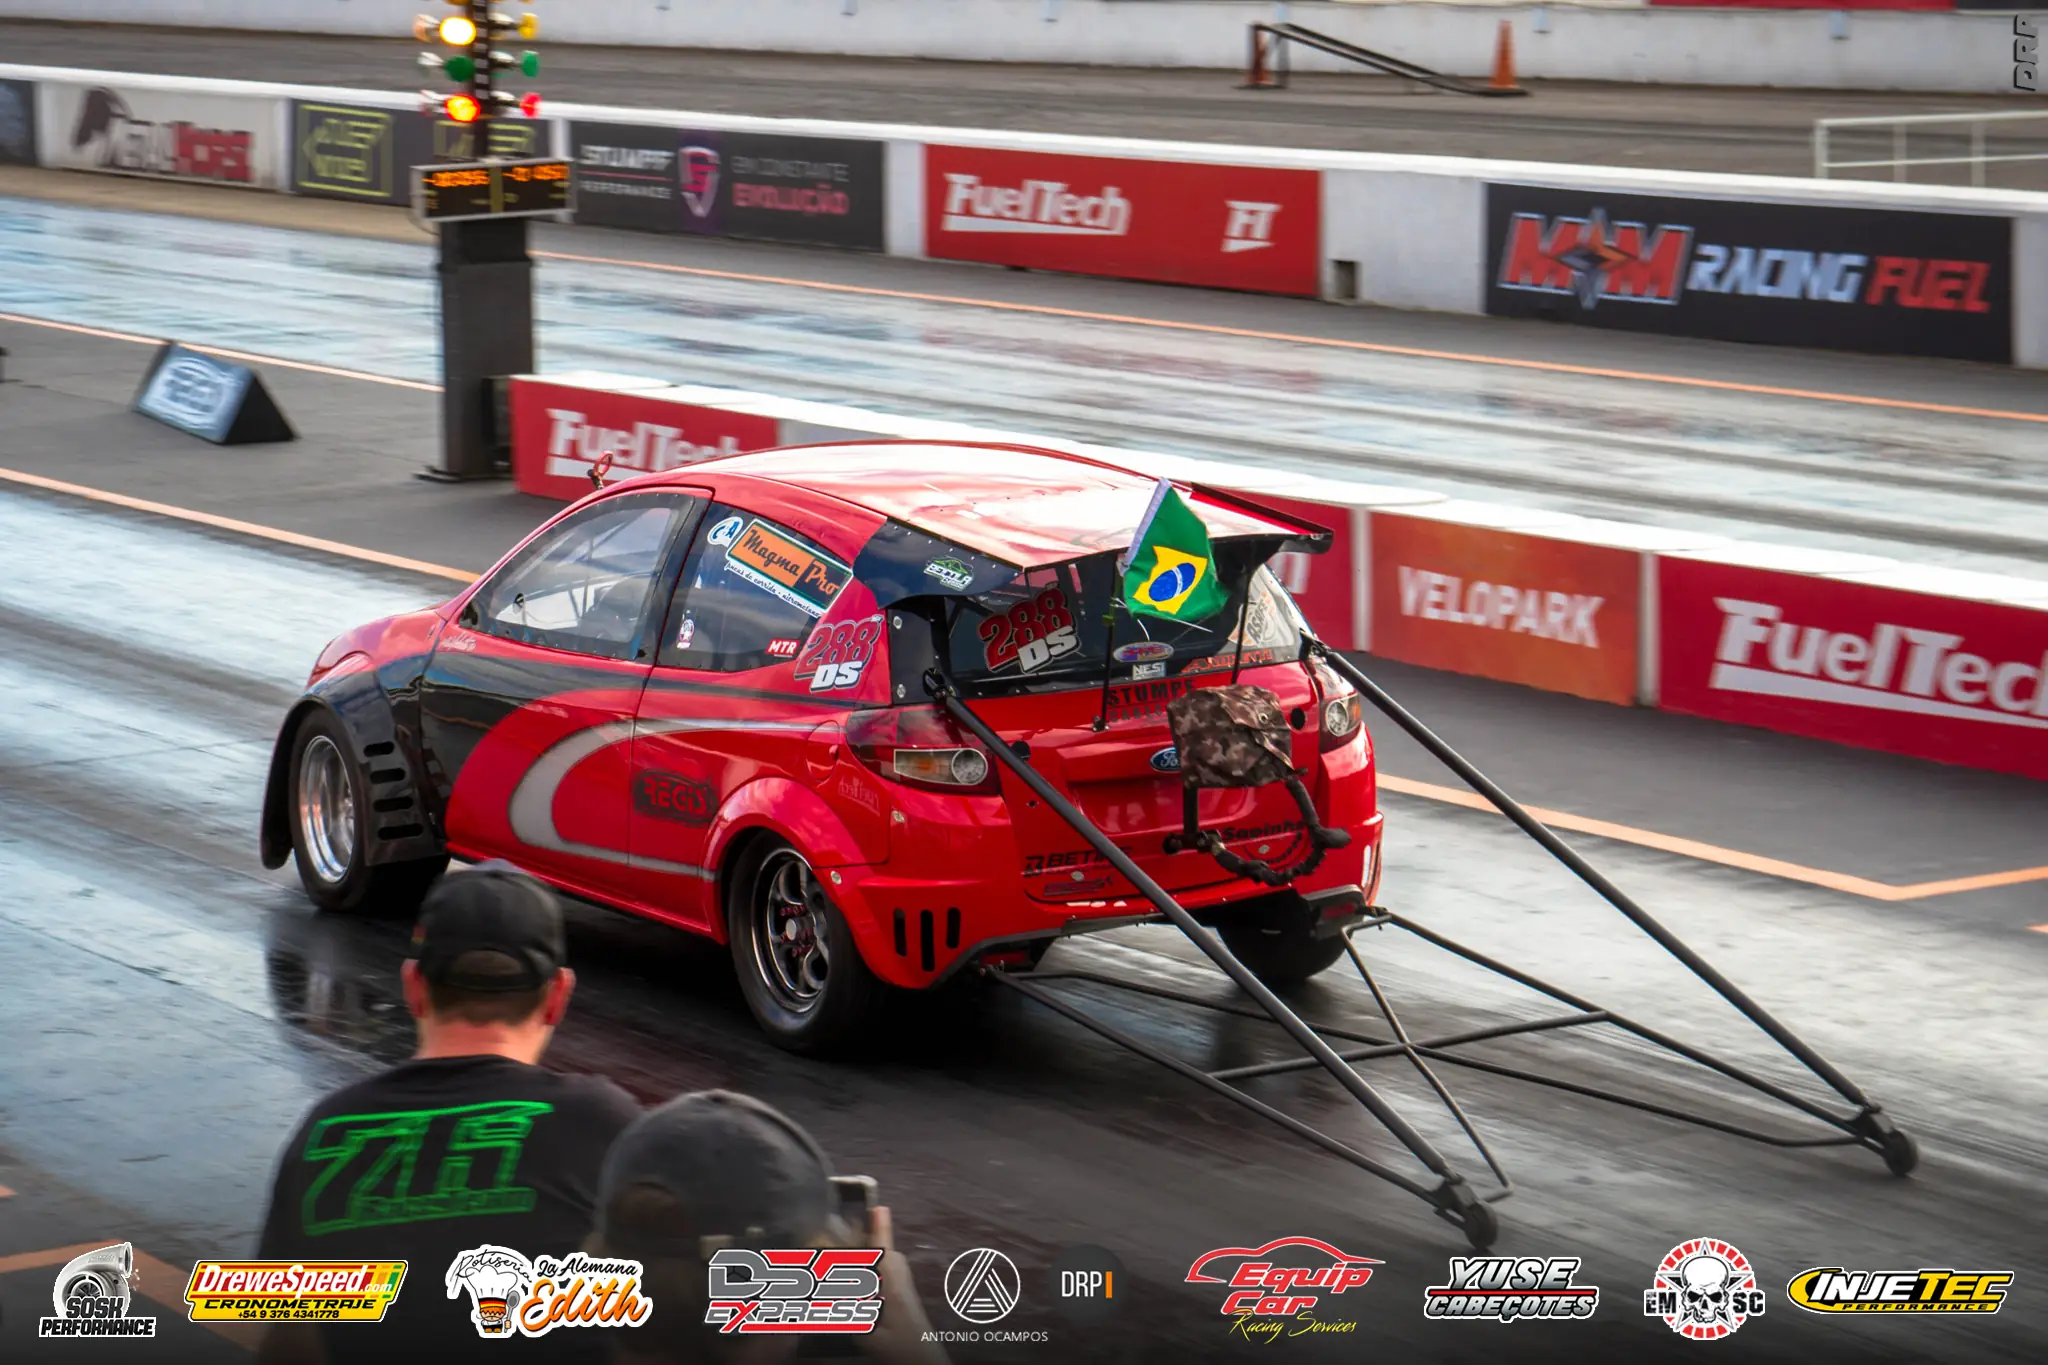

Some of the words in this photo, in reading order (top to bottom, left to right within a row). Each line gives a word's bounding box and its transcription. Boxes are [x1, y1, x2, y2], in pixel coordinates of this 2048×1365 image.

[944, 172, 1131, 229] FuelTech
[1687, 243, 1868, 303] RACING
[1865, 254, 1993, 312] FUEL
[743, 529, 799, 577] Magma
[804, 557, 841, 596] Pro
[976, 584, 1077, 674] 288
[1397, 565, 1605, 649] VELOPARK
[767, 640, 797, 654] MTR
[793, 615, 884, 681] 288
[809, 660, 864, 693] DS
[1017, 624, 1081, 674] DS
